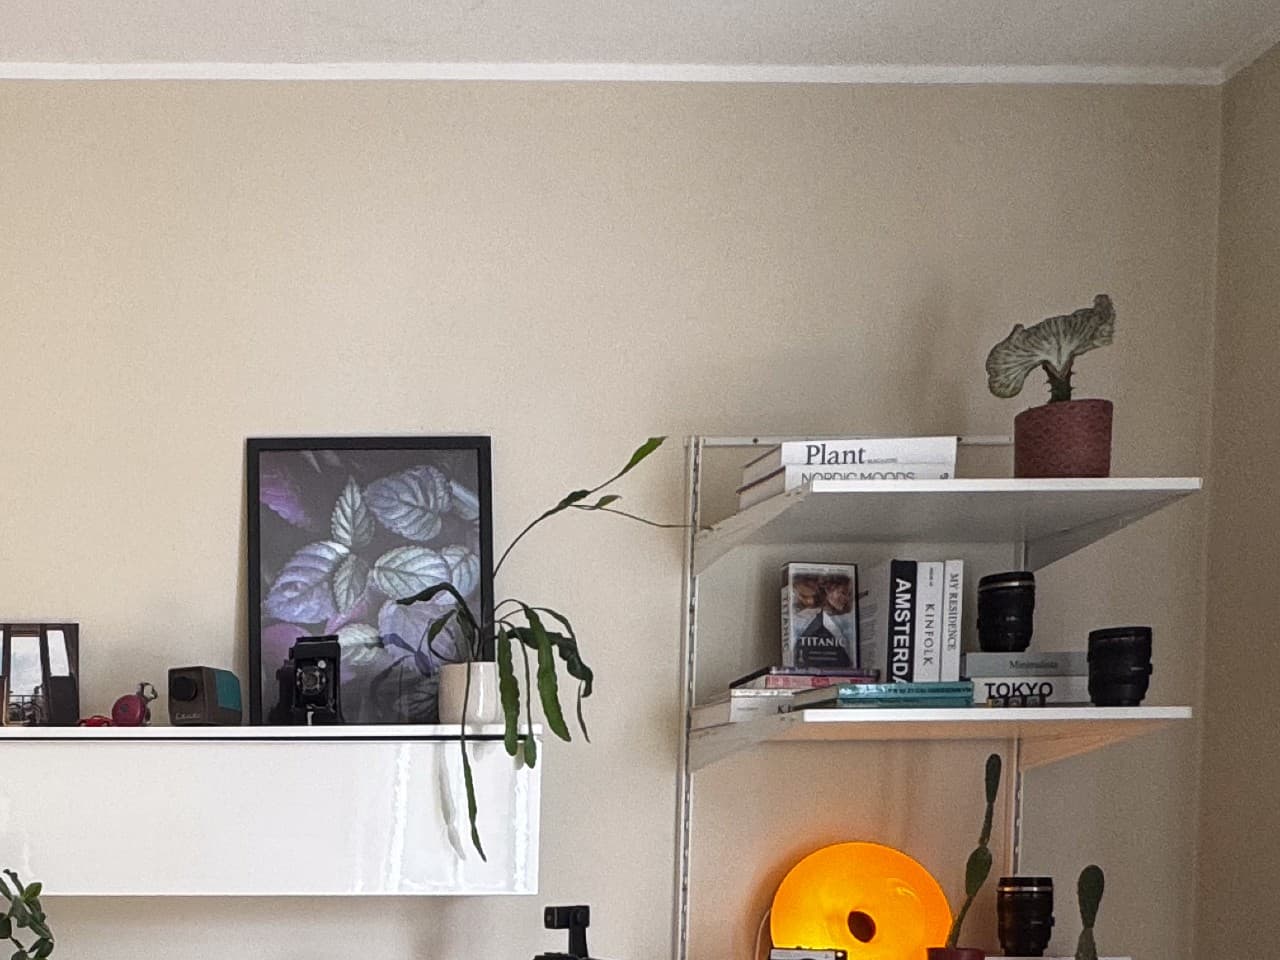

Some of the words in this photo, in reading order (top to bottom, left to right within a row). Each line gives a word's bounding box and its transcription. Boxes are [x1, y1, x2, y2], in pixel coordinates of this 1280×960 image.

[805, 443, 866, 465] Plant
[949, 572, 959, 591] MY
[947, 593, 958, 651] RESIDENCE
[800, 636, 847, 648] TITANIC
[922, 603, 935, 666] KINFOLK
[984, 682, 1053, 699] TOKYO
